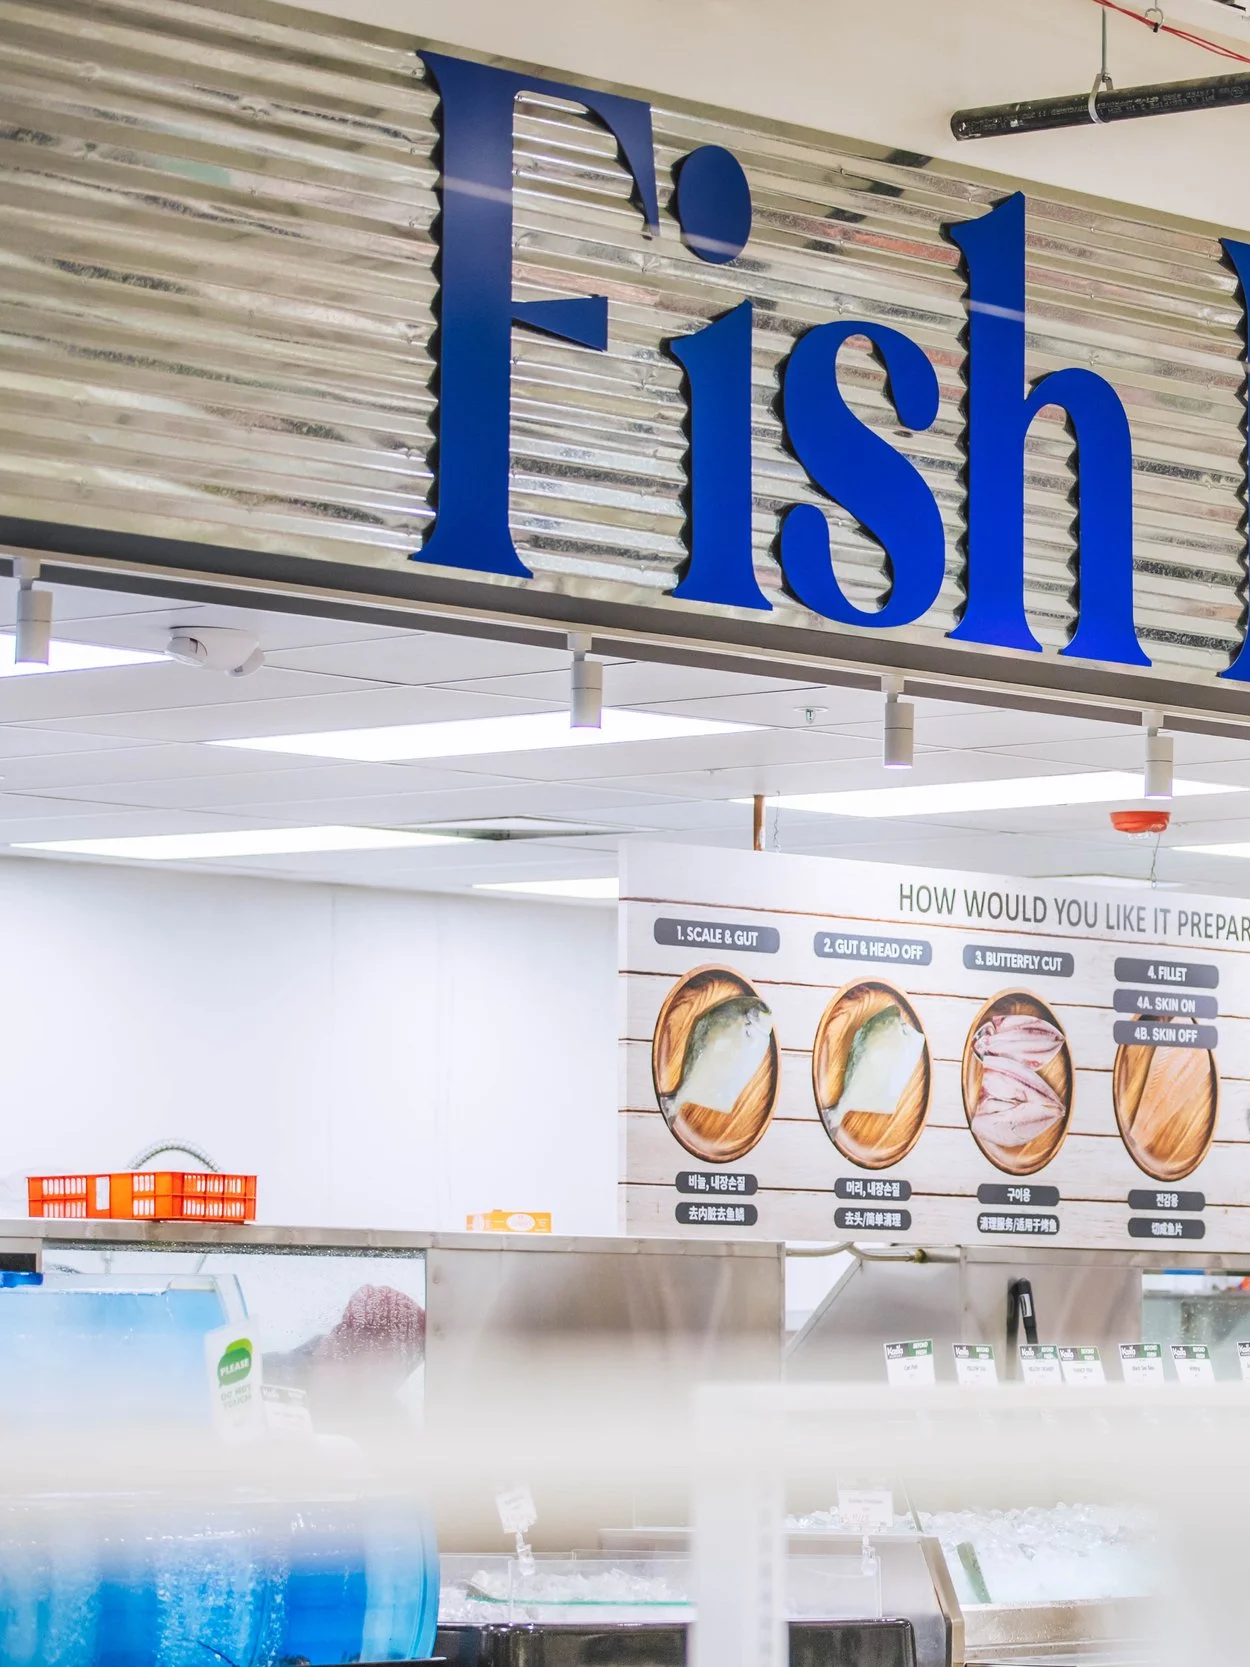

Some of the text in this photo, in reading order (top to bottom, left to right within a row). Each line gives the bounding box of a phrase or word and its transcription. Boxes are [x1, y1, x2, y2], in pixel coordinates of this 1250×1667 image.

[408, 50, 1152, 668] Fish
[899, 883, 957, 915] HOW
[963, 889, 1048, 923] WOULD
[1053, 898, 1098, 928] YOU
[1105, 902, 1147, 933] LIKE
[1153, 907, 1171, 935] IT
[676, 925, 759, 947] 1. SCALE & GUT
[823, 938, 923, 960] 2. GUT & HEAD OFF
[974, 951, 1063, 971] 3. BUTTERFLY CUT
[1147, 965, 1188, 982] 4. FILLET
[1155, 998, 1180, 1012] SKIN
[1180, 999, 1196, 1013] ON
[1152, 1027, 1177, 1042] SKIN
[1178, 1029, 1198, 1043] OFF
[710, 1174, 746, 1191] 내장손질
[867, 1181, 900, 1197] 내장손질
[220, 1358, 250, 1376] PLEASE
